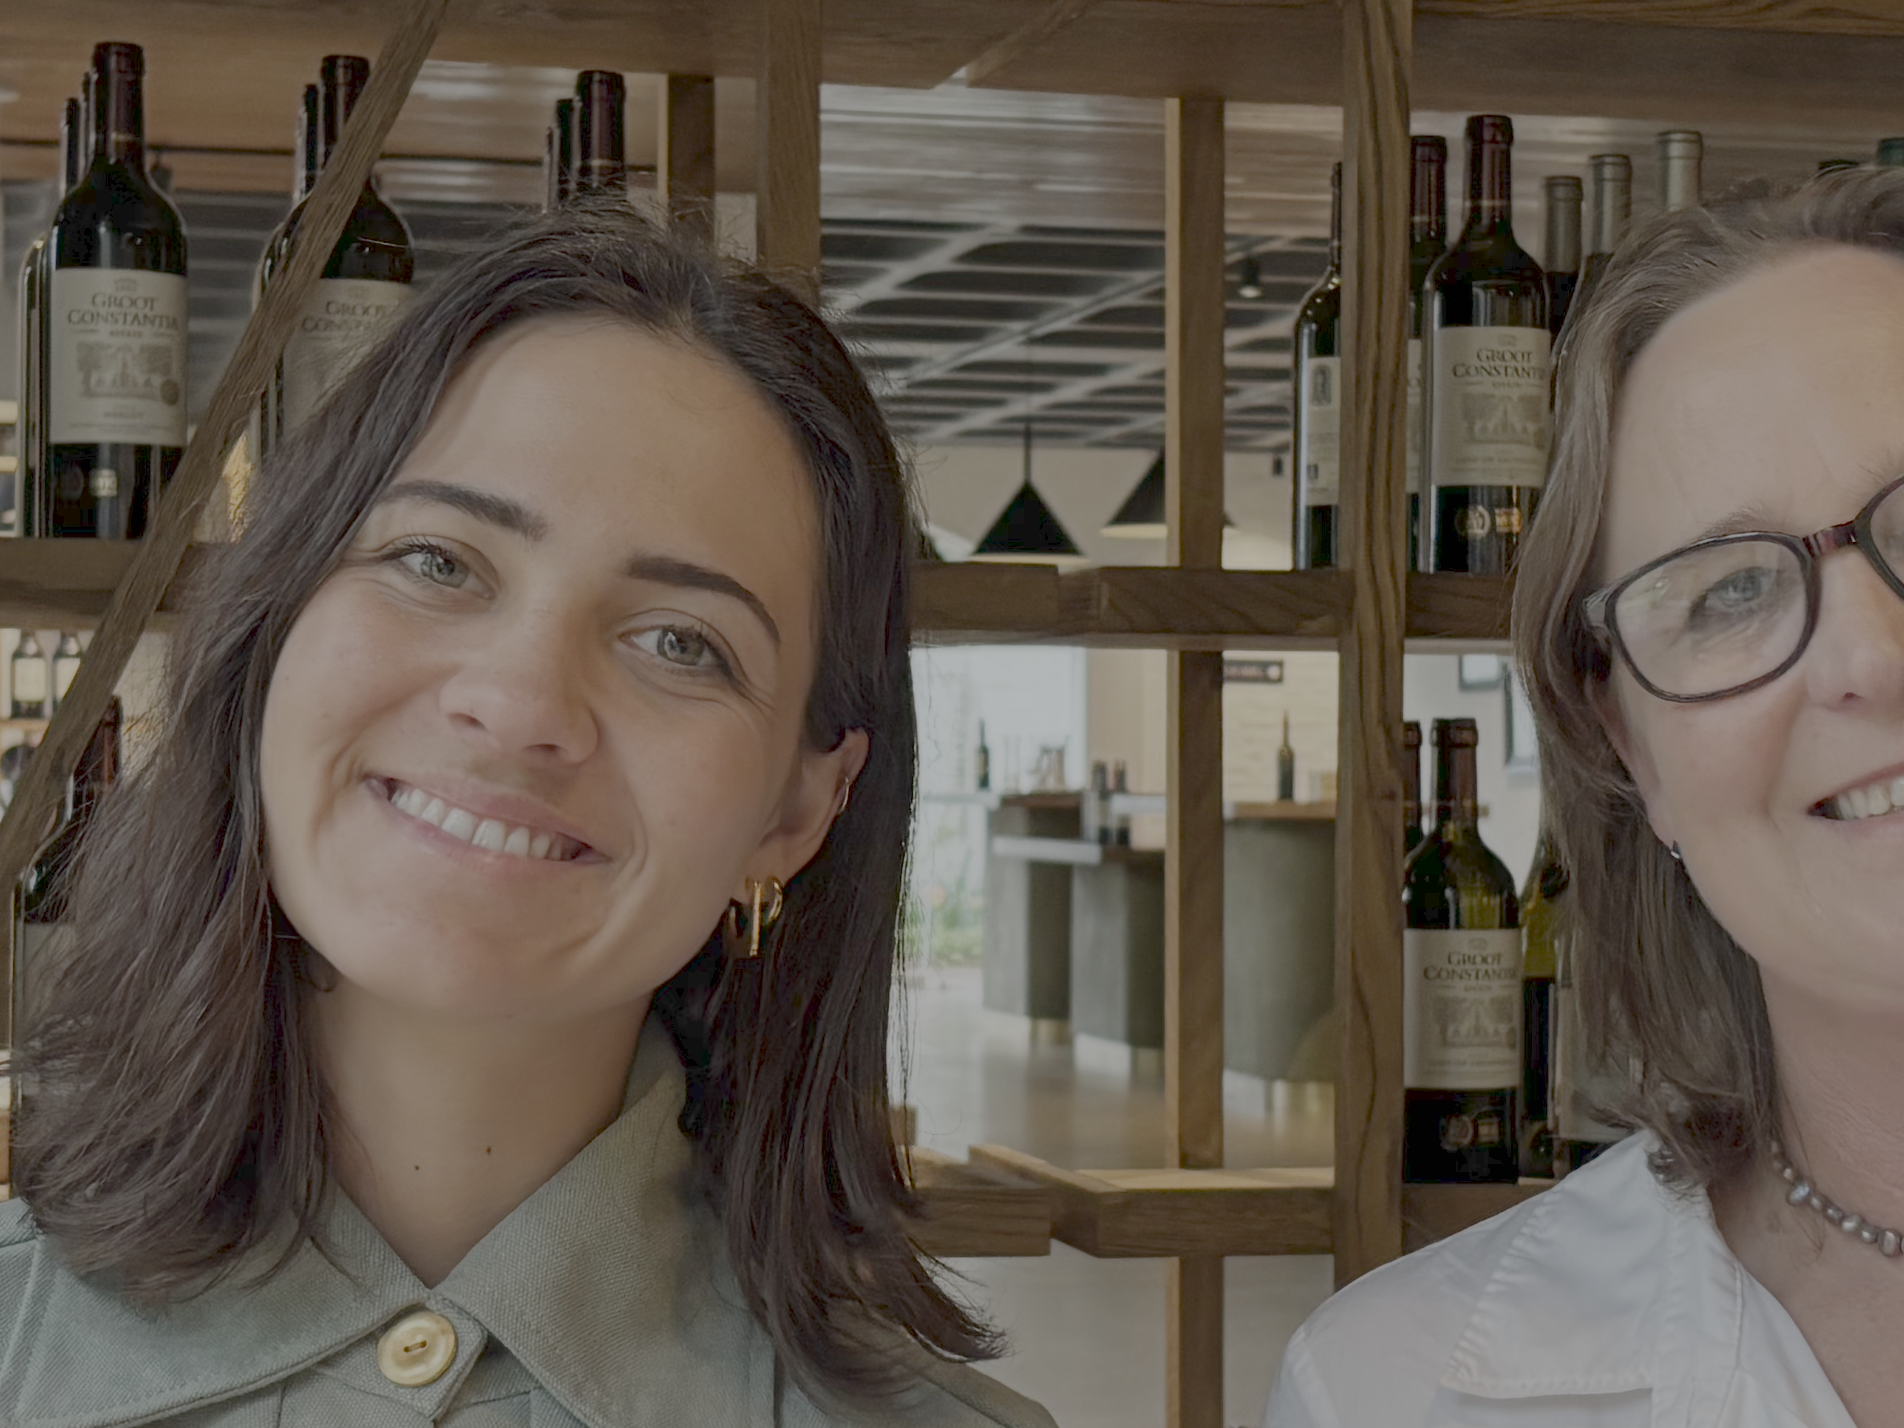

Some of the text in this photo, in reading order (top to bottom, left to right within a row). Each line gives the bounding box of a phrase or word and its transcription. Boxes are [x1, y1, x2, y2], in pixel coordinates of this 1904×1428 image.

[91, 291, 158, 311] GROOT
[67, 309, 181, 331] CONSTANTIA
[1477, 348, 1533, 364] GROOT
[1447, 952, 1502, 967] GROOT
